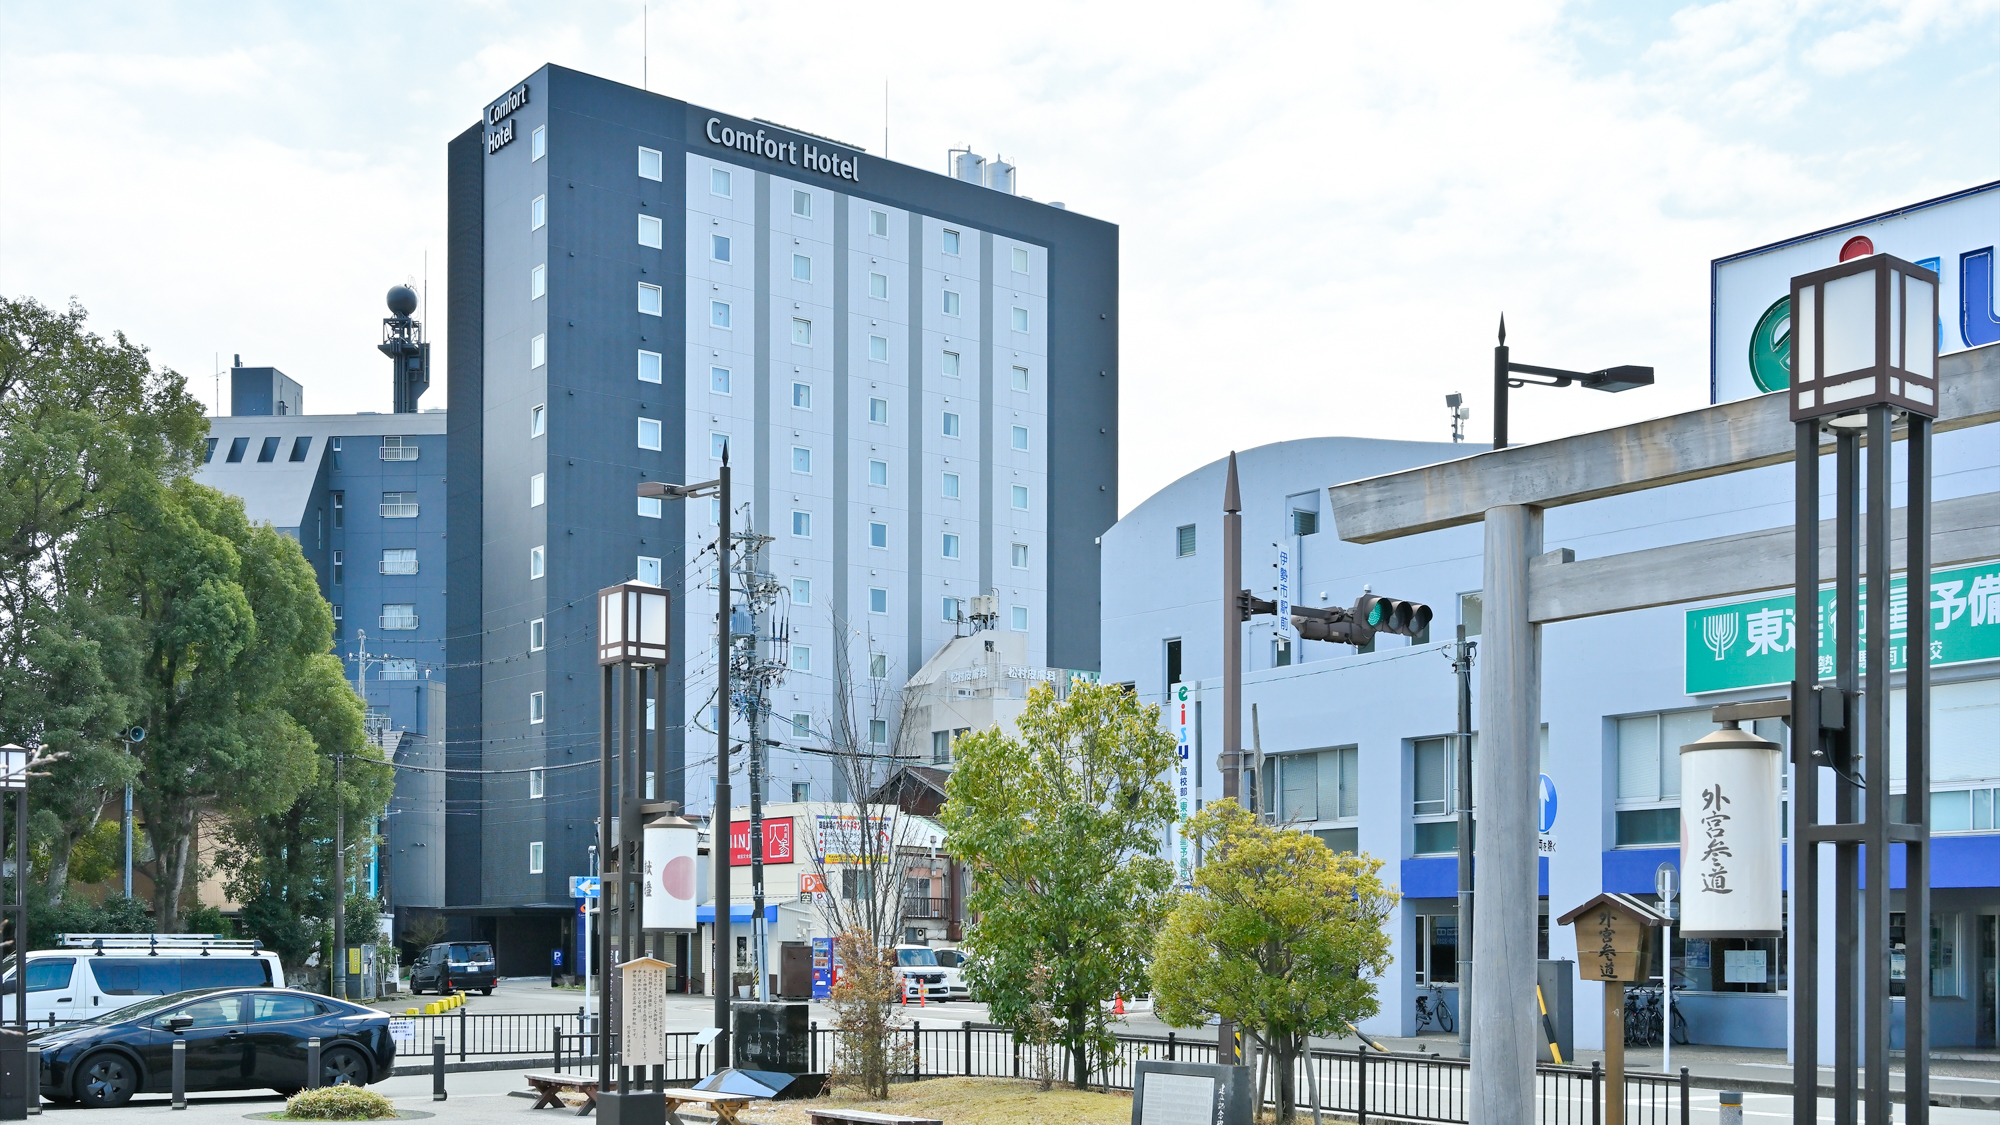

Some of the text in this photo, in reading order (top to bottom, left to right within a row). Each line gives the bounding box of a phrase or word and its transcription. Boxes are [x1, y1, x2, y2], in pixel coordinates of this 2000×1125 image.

[488, 83, 526, 126] Comfort
[488, 119, 513, 154] Hotel
[706, 117, 859, 182] Comfort Hotel
[1280, 551, 1289, 631] 伊勢市駅前
[1008, 666, 1056, 682] 松村皮膚科
[1701, 783, 1733, 895] 外宮参道
[553, 951, 562, 960] P
[1598, 910, 1618, 979] 外宮参道
